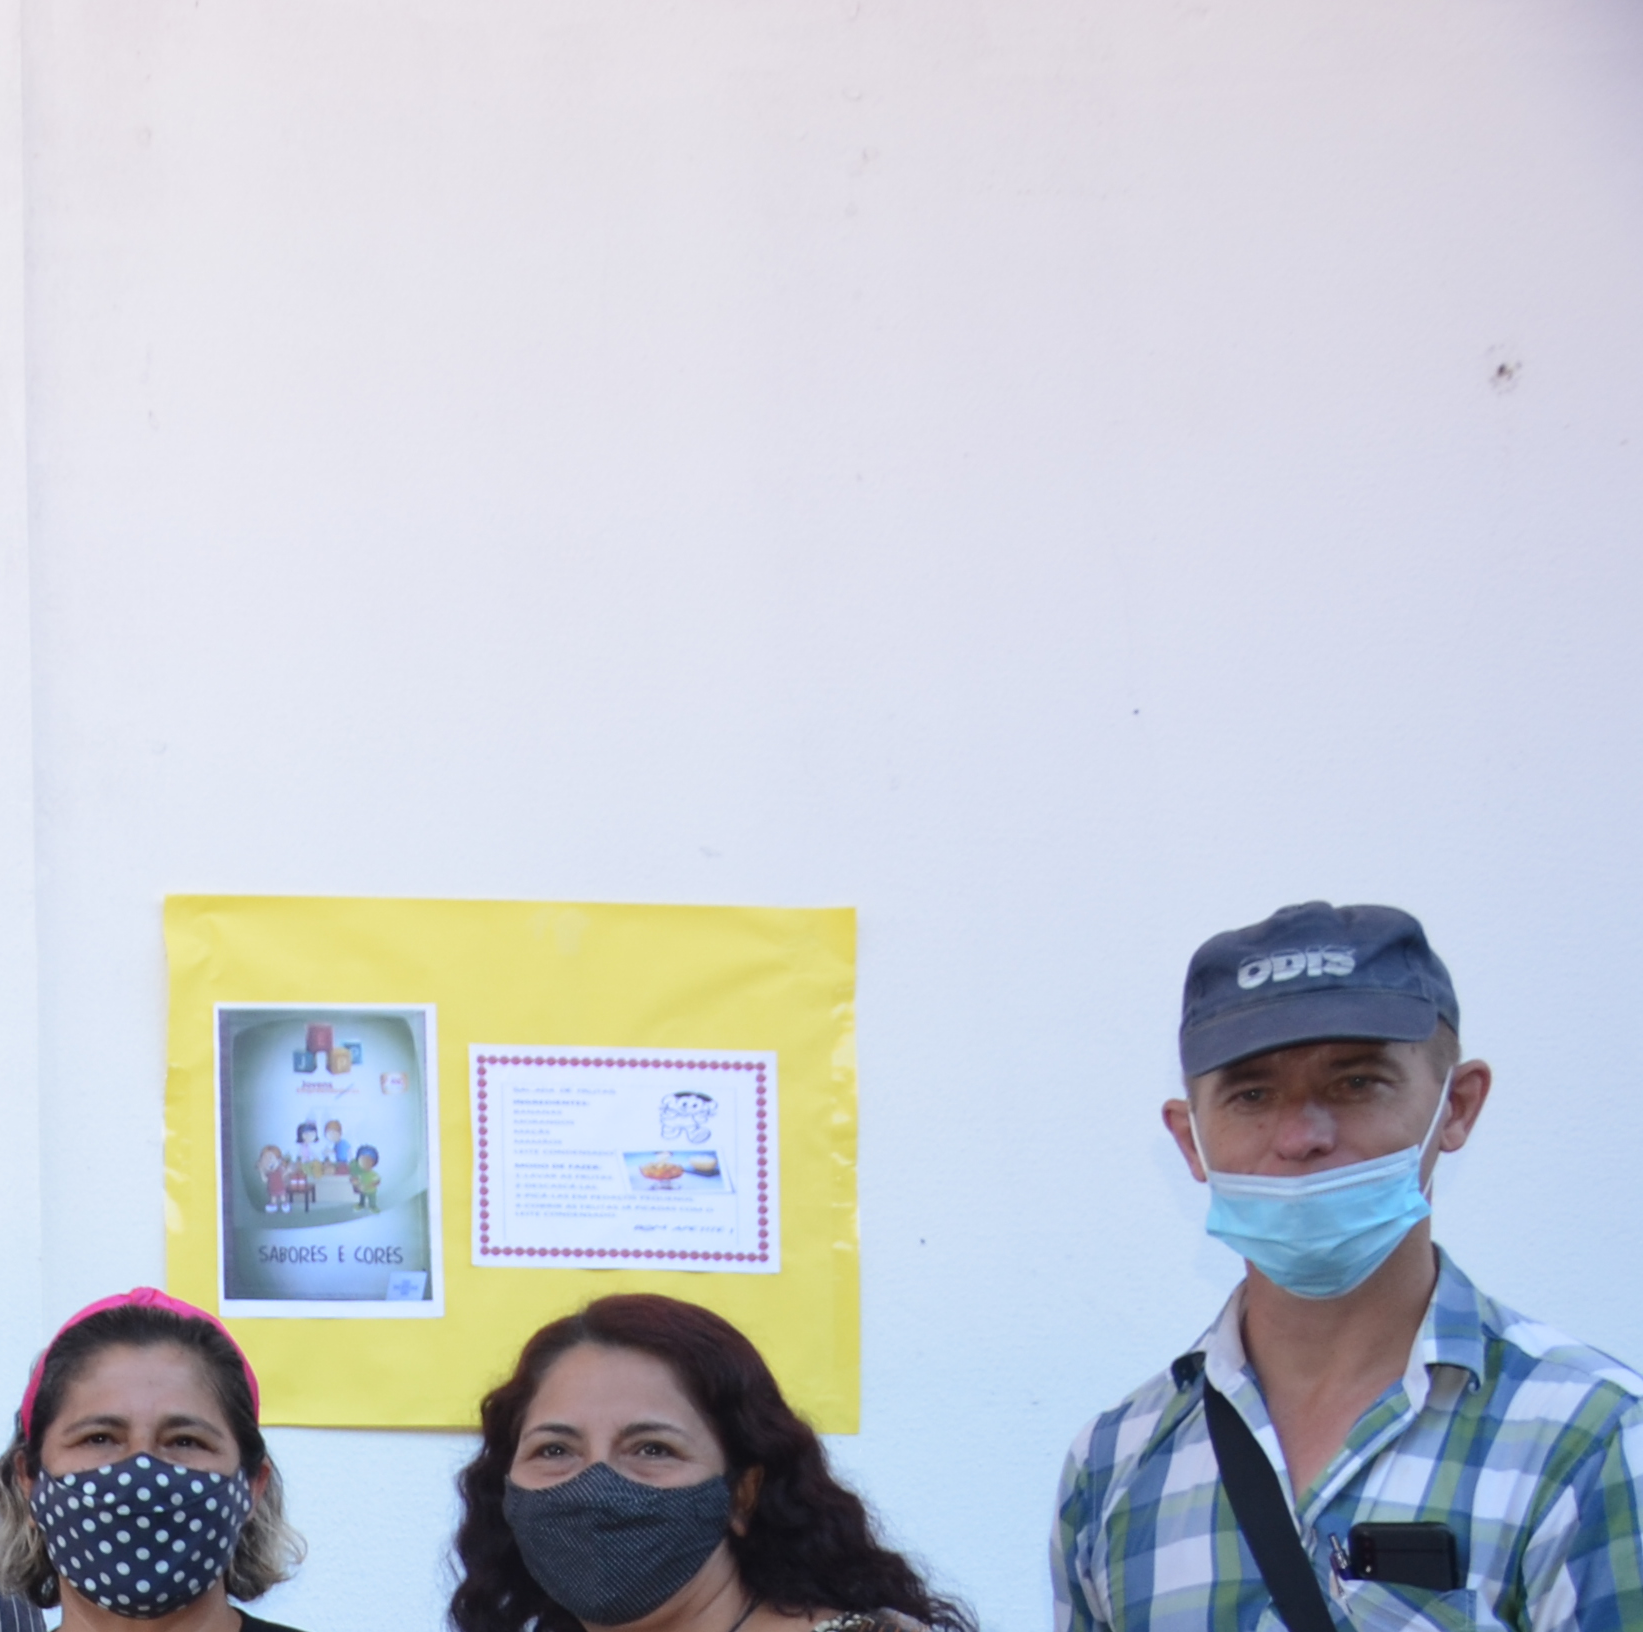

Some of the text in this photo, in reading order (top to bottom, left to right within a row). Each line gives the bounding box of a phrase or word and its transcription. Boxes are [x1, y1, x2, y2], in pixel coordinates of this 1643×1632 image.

[258, 1245, 404, 1265] SABORES E CORES
